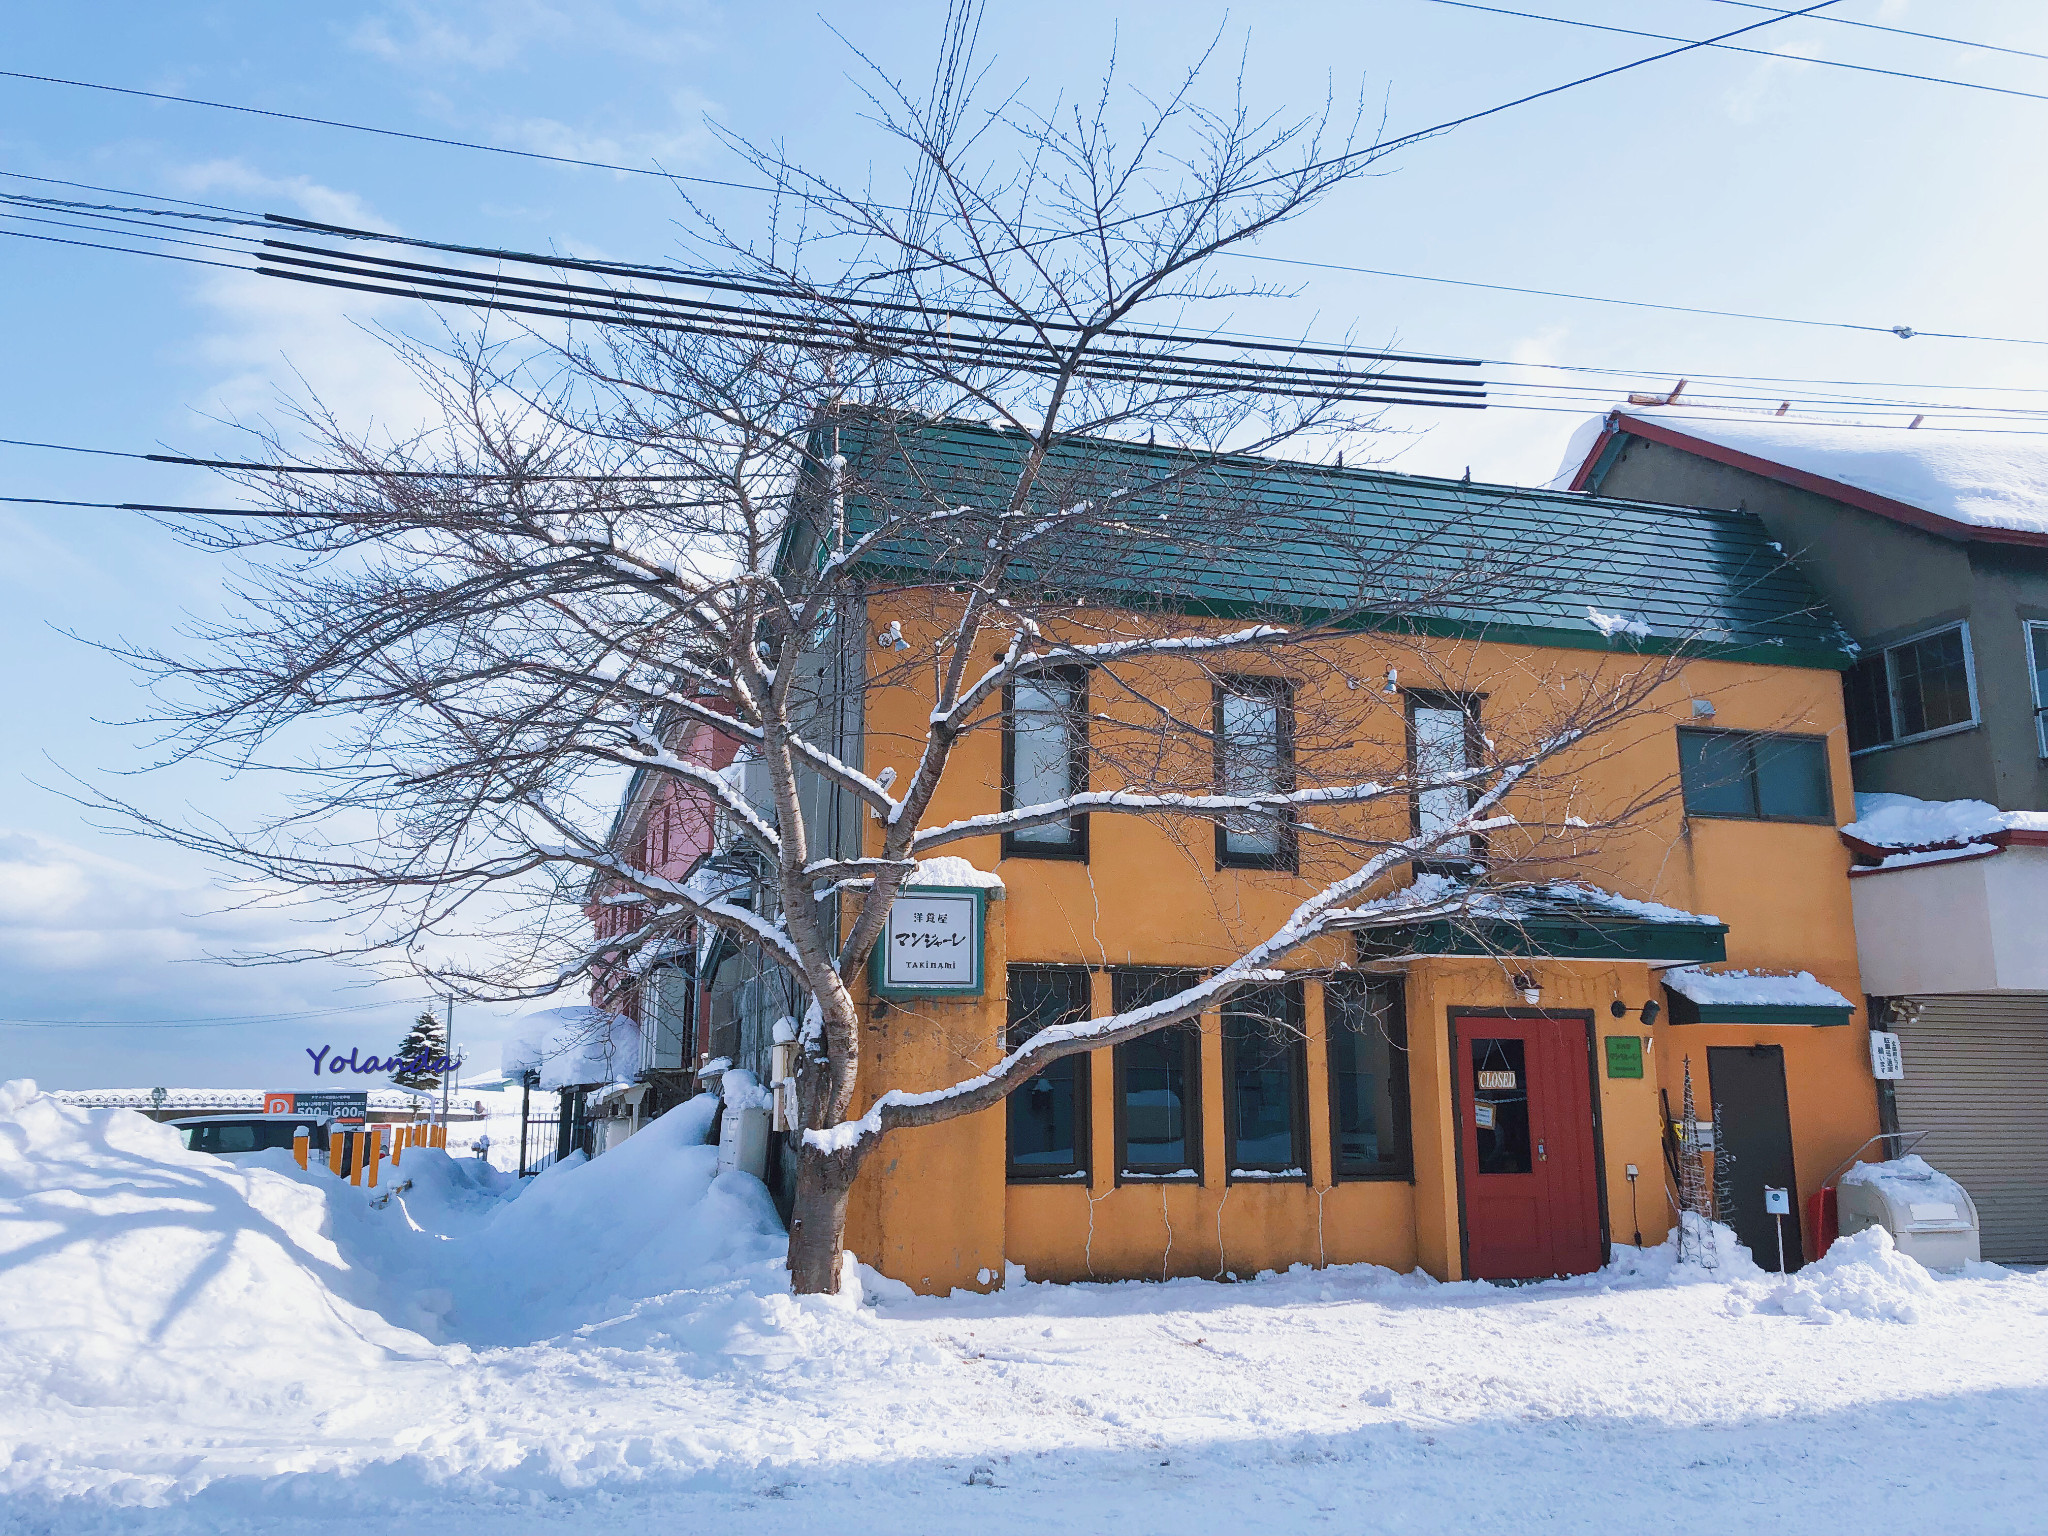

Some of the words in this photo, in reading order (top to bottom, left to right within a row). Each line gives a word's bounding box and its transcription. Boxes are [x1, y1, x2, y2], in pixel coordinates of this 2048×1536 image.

[895, 932, 967, 949] マンジャーレ
[1479, 1072, 1516, 1088] CLOSED
